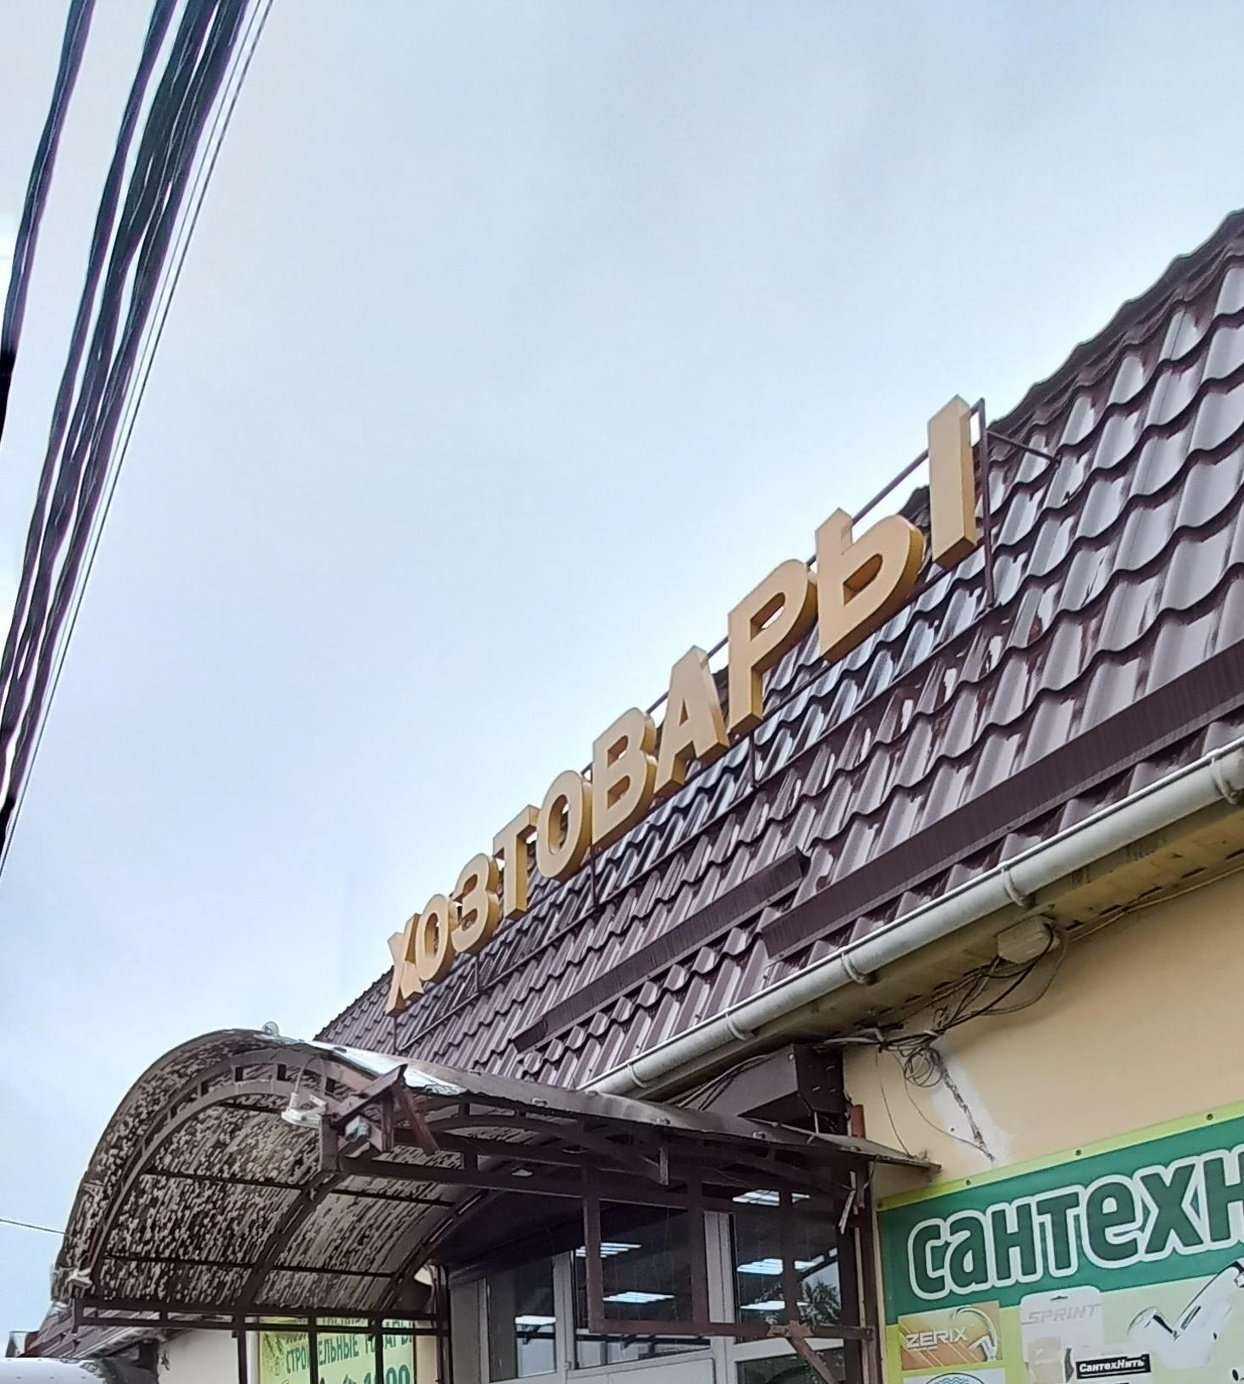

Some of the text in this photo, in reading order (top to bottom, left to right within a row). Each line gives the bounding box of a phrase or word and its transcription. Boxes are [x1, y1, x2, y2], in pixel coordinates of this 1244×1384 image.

[386, 394, 979, 1016] ХОЗТОВАРЫ
[1025, 1303, 1102, 1324] SPRINT
[286, 1332, 359, 1374] СТРОЕЛЬНЫЕ
[905, 1327, 968, 1349] ZERIX
